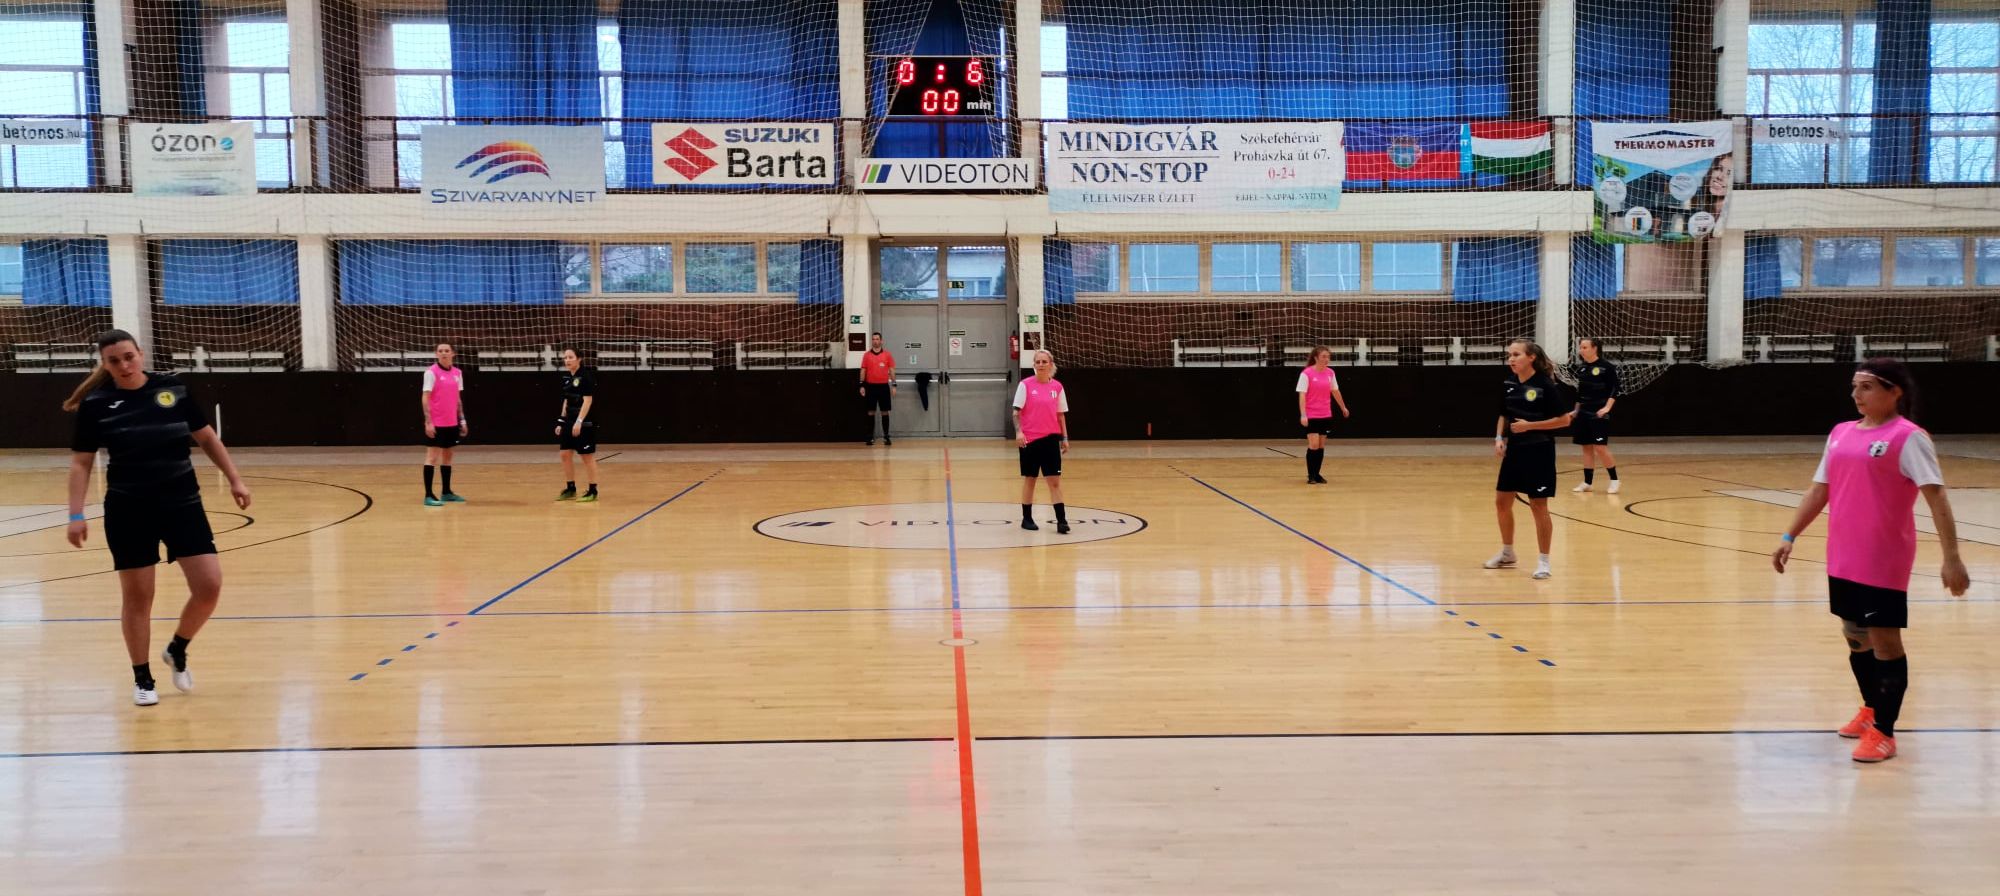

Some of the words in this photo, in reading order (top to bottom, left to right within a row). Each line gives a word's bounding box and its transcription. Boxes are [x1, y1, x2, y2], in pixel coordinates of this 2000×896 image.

[899, 60, 914, 84] 0
[967, 60, 983, 84] 6
[923, 89, 960, 113] 00
[966, 101, 992, 111] min
[151, 126, 217, 152] ózon
[724, 127, 820, 144] SUZUKI
[1058, 125, 1220, 152] MINDIGVÁR
[1614, 139, 1716, 150] THERMOMASTER
[726, 147, 826, 178] Barta
[1313, 148, 1331, 160] 67.
[900, 163, 1029, 184] VIDEOTON
[1070, 162, 1209, 183] NON-STOP
[1267, 167, 1296, 180] 0-24
